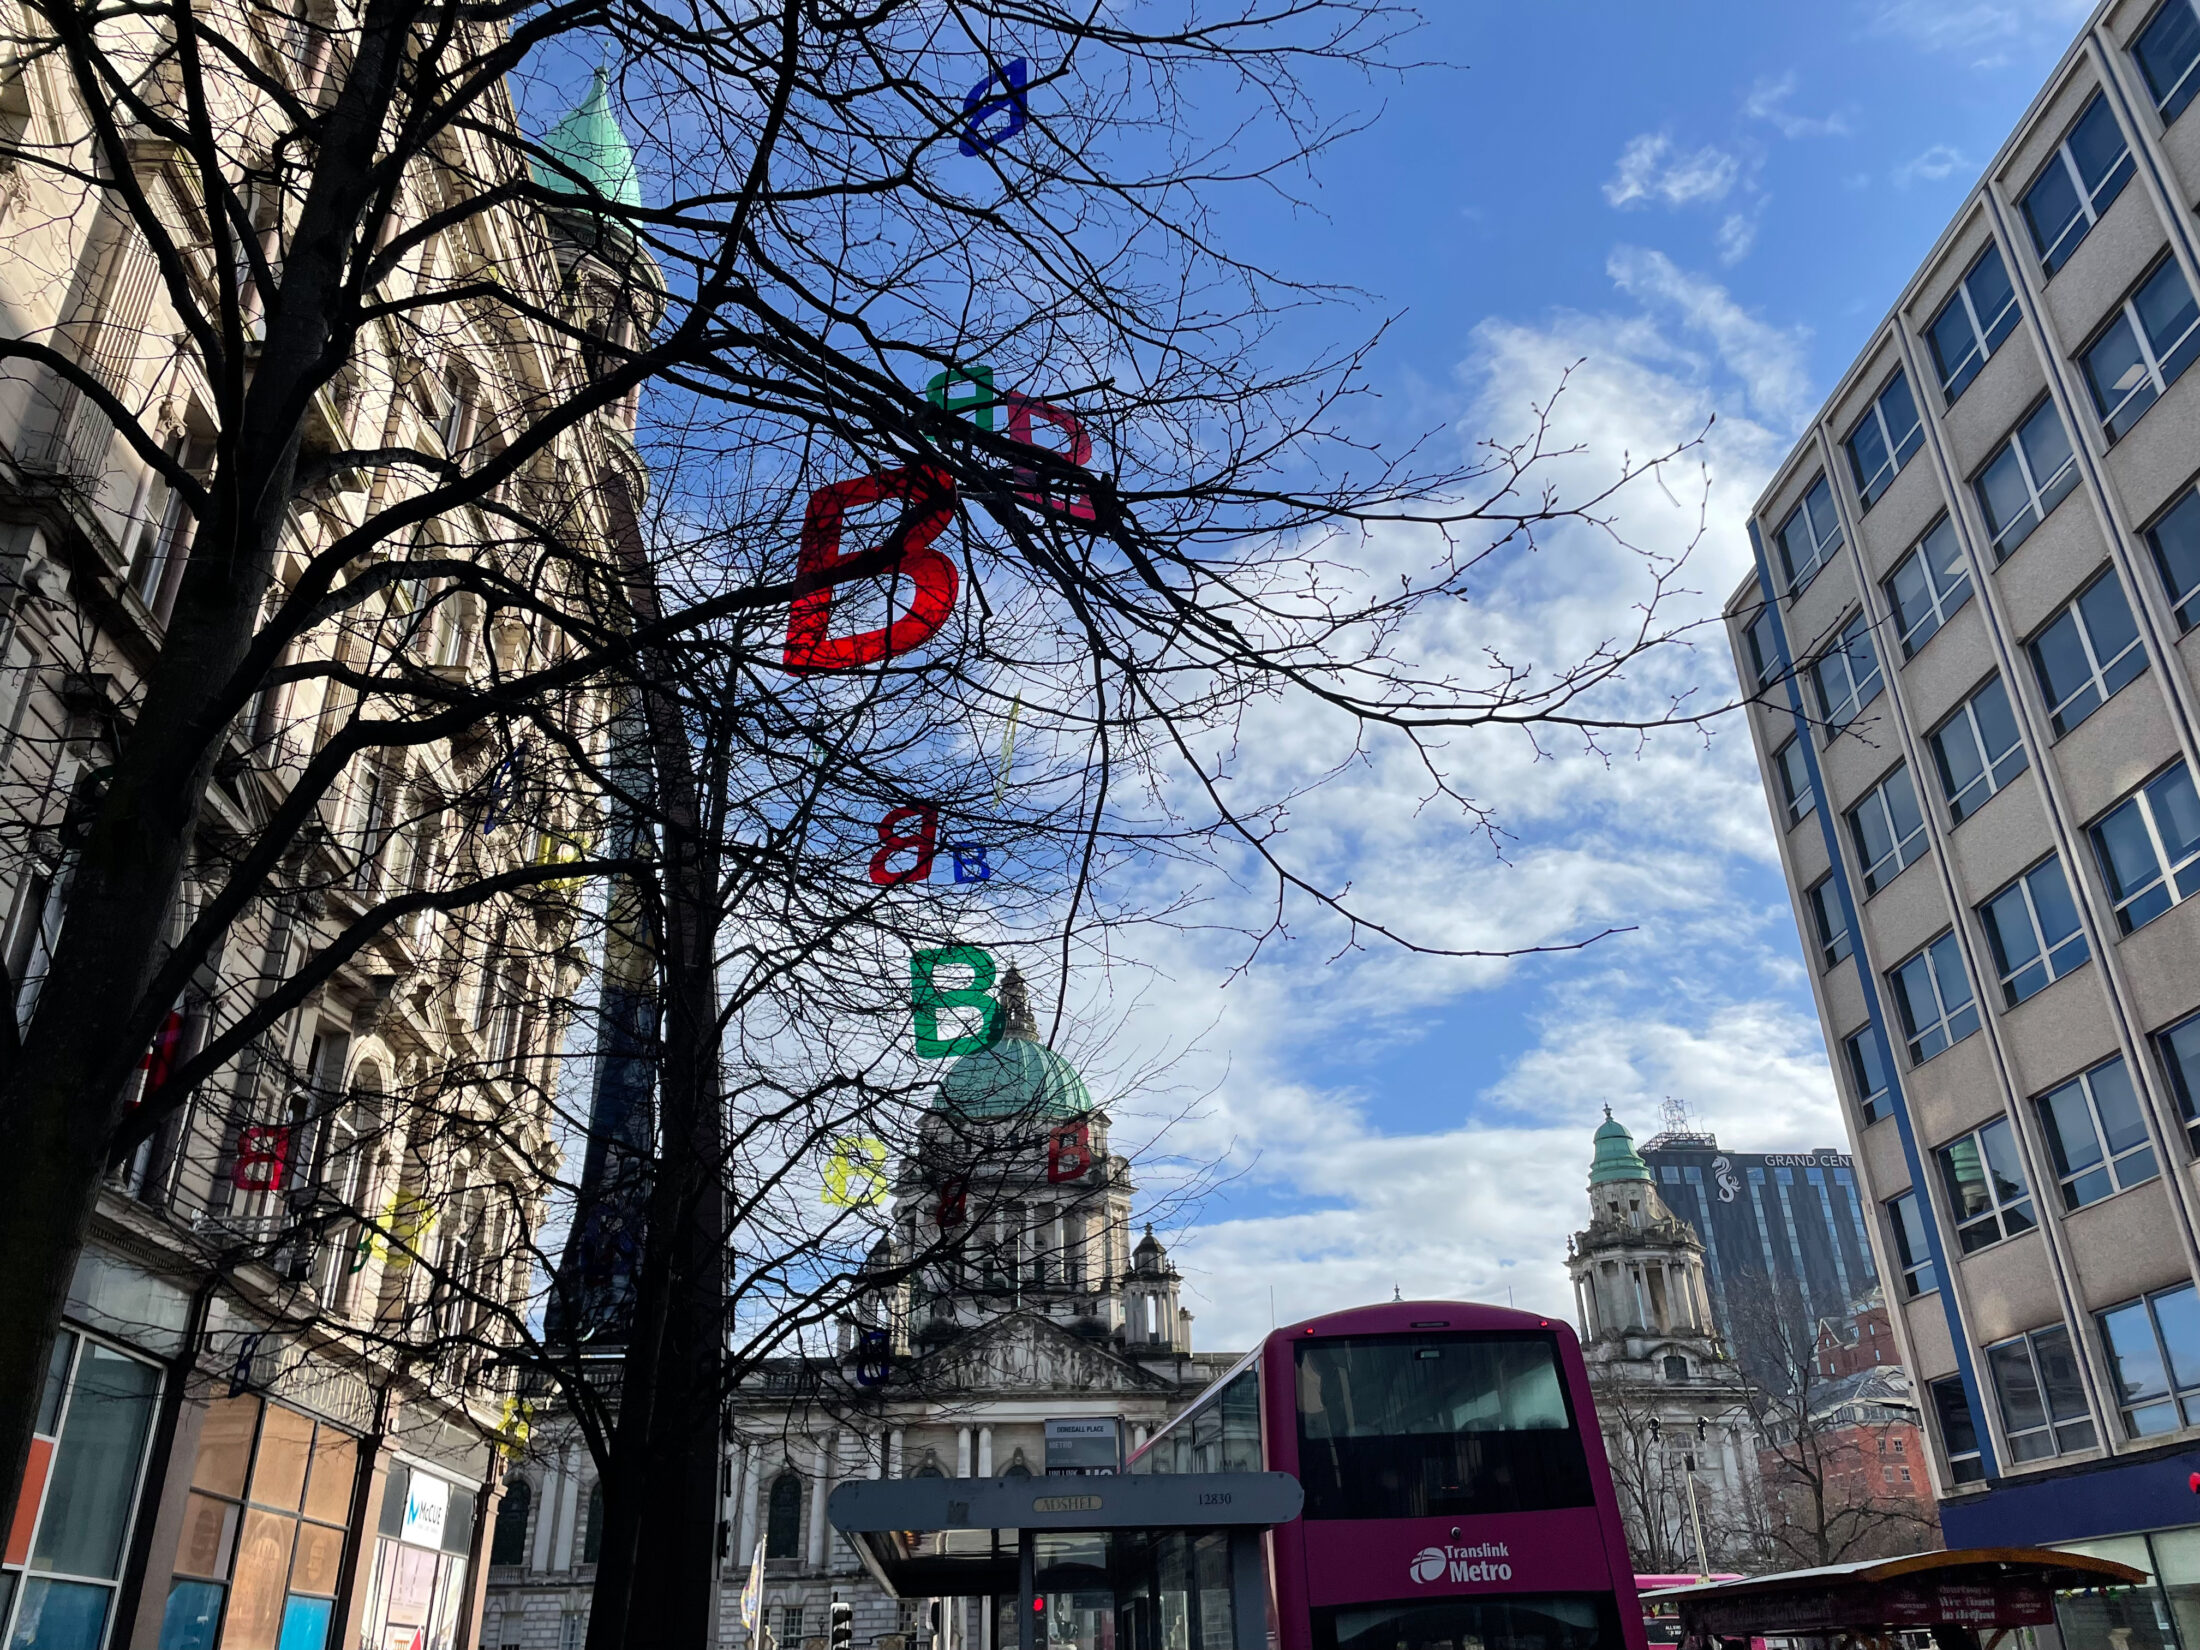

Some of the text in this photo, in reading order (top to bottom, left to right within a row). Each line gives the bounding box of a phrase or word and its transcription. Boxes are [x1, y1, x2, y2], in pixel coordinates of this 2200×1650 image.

[783, 463, 959, 677] B
[953, 841, 990, 884] B
[910, 946, 1007, 1060] B
[1048, 1122, 1091, 1184] B
[1764, 1154, 1816, 1167] GRAND
[1048, 1441, 1073, 1449] METRO
[1199, 1493, 1232, 1505] 12830
[419, 1501, 442, 1525] McCUE
[1444, 1542, 1510, 1559] Translink
[1449, 1560, 1513, 1583] Metro
